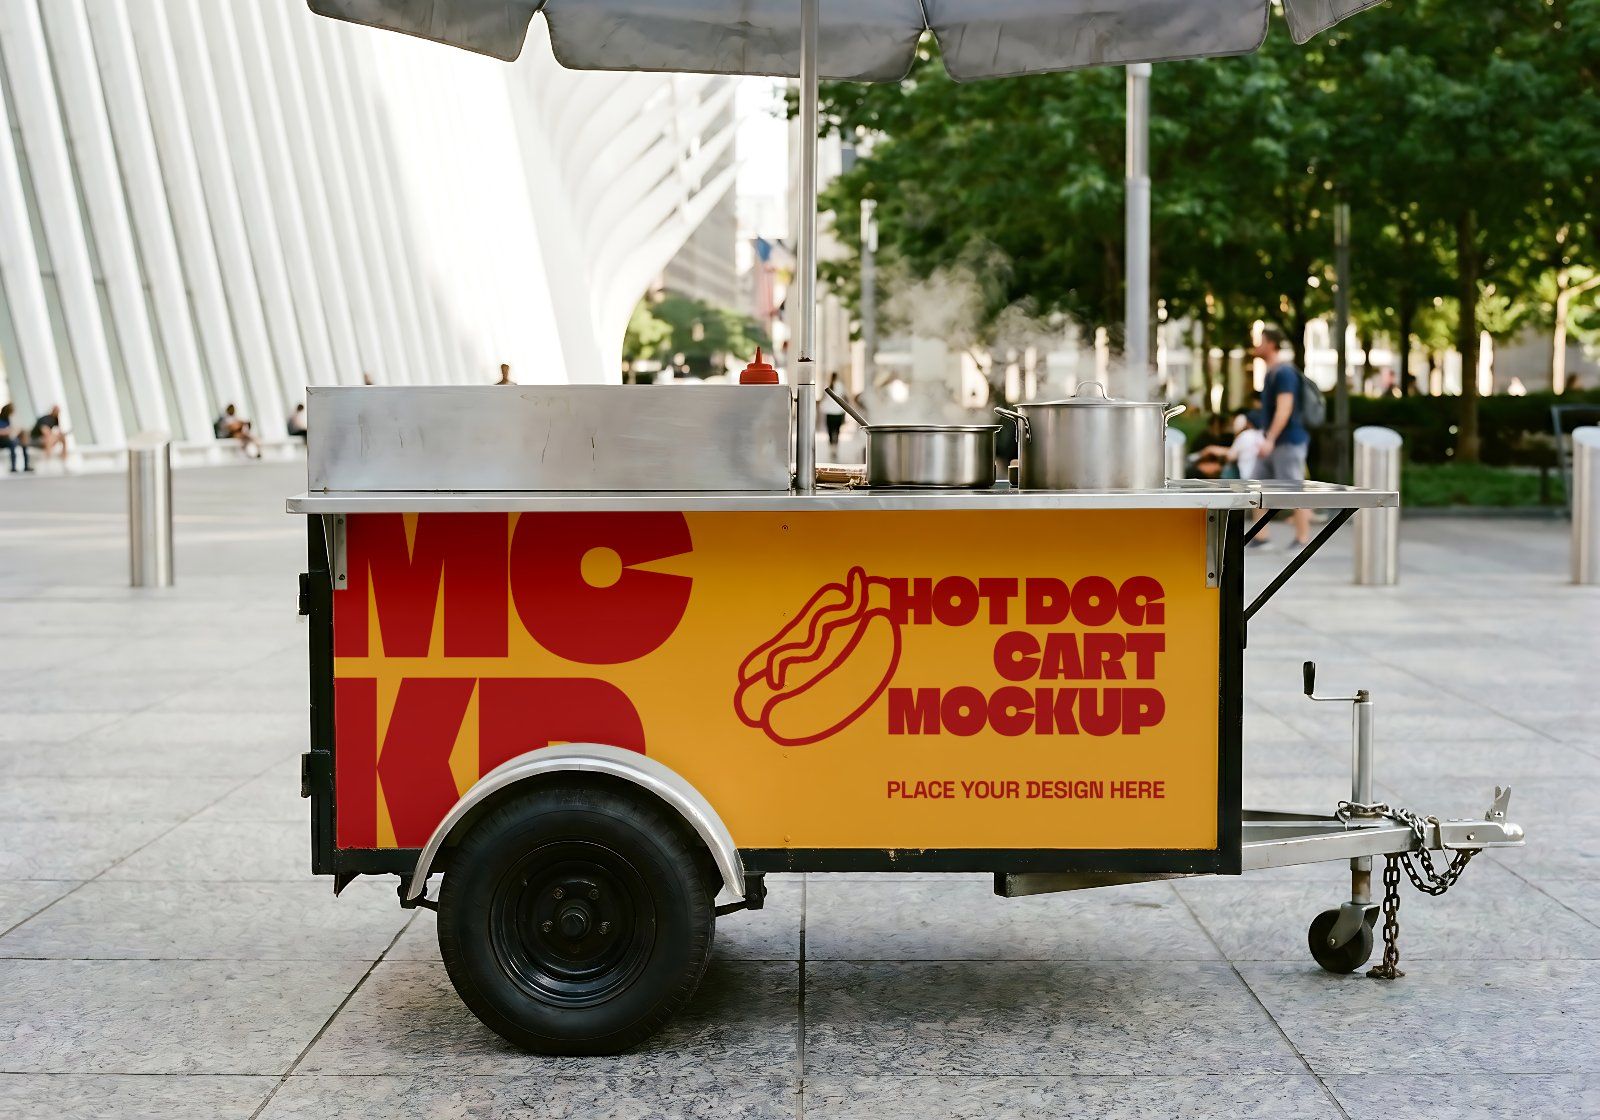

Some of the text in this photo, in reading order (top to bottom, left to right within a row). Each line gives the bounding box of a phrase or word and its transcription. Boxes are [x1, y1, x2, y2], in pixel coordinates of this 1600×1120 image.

[333, 511, 693, 664] MC
[890, 576, 1165, 626] HOT DOG
[994, 631, 1165, 681] CART
[888, 686, 1165, 736] MOCKUP
[887, 780, 1165, 799] PLACE YOUR DESIGN HERE
